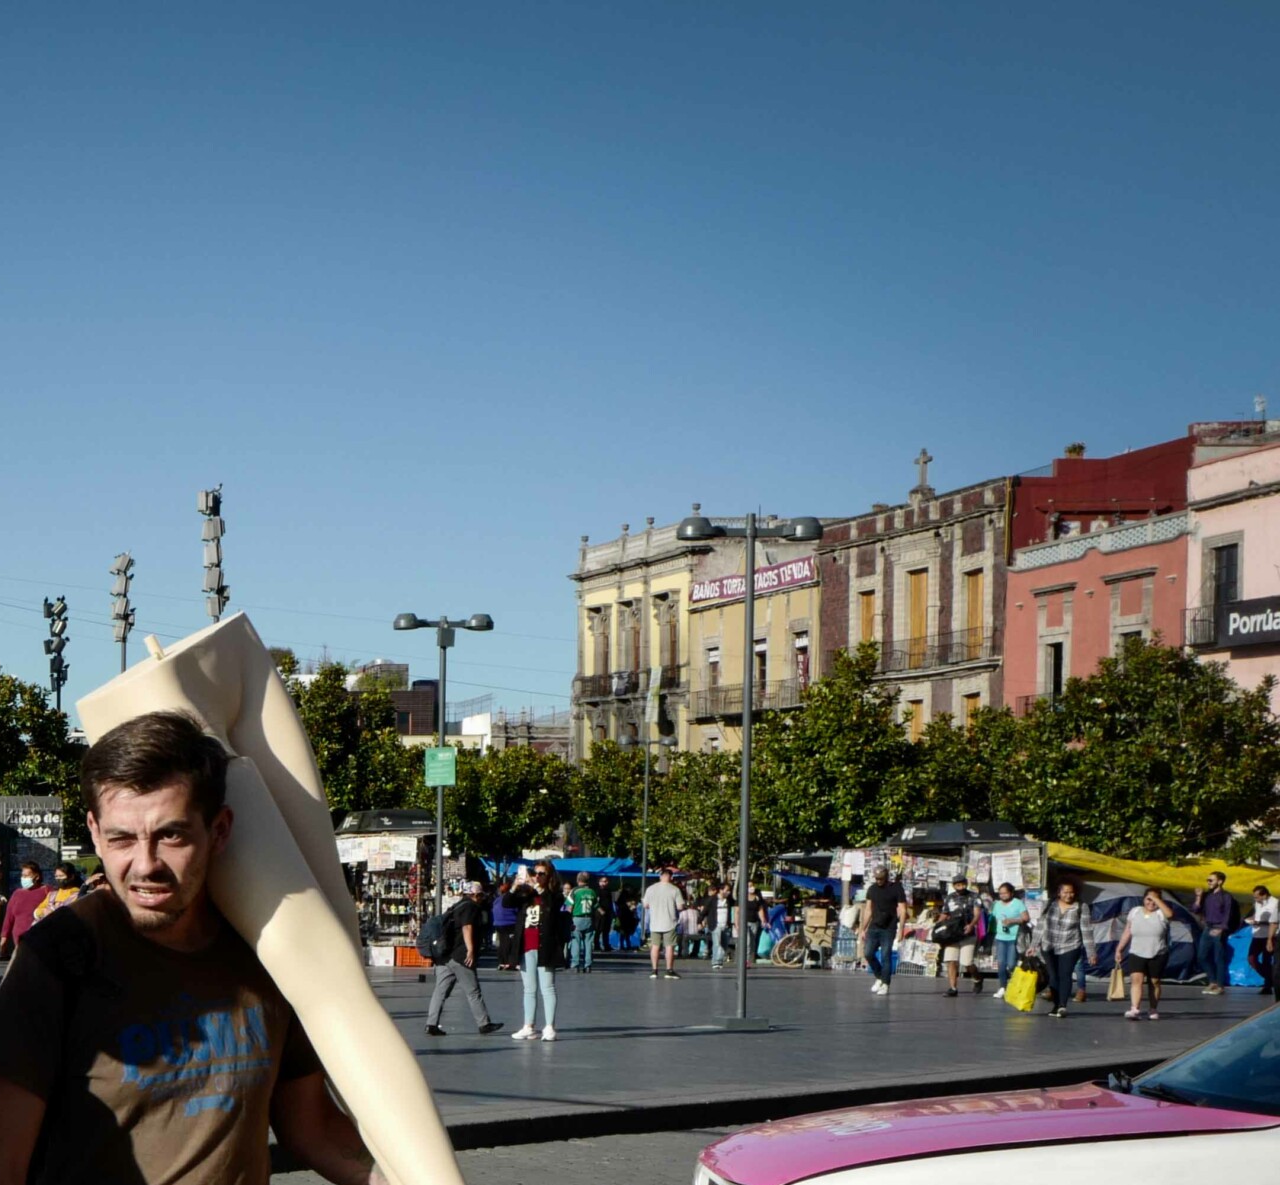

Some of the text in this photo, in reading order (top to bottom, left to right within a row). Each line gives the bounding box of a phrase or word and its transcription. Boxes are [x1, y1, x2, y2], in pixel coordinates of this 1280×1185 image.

[754, 569, 778, 589] TACOS
[1229, 609, 1280, 635] Porrúa
[43, 812, 60, 823] de
